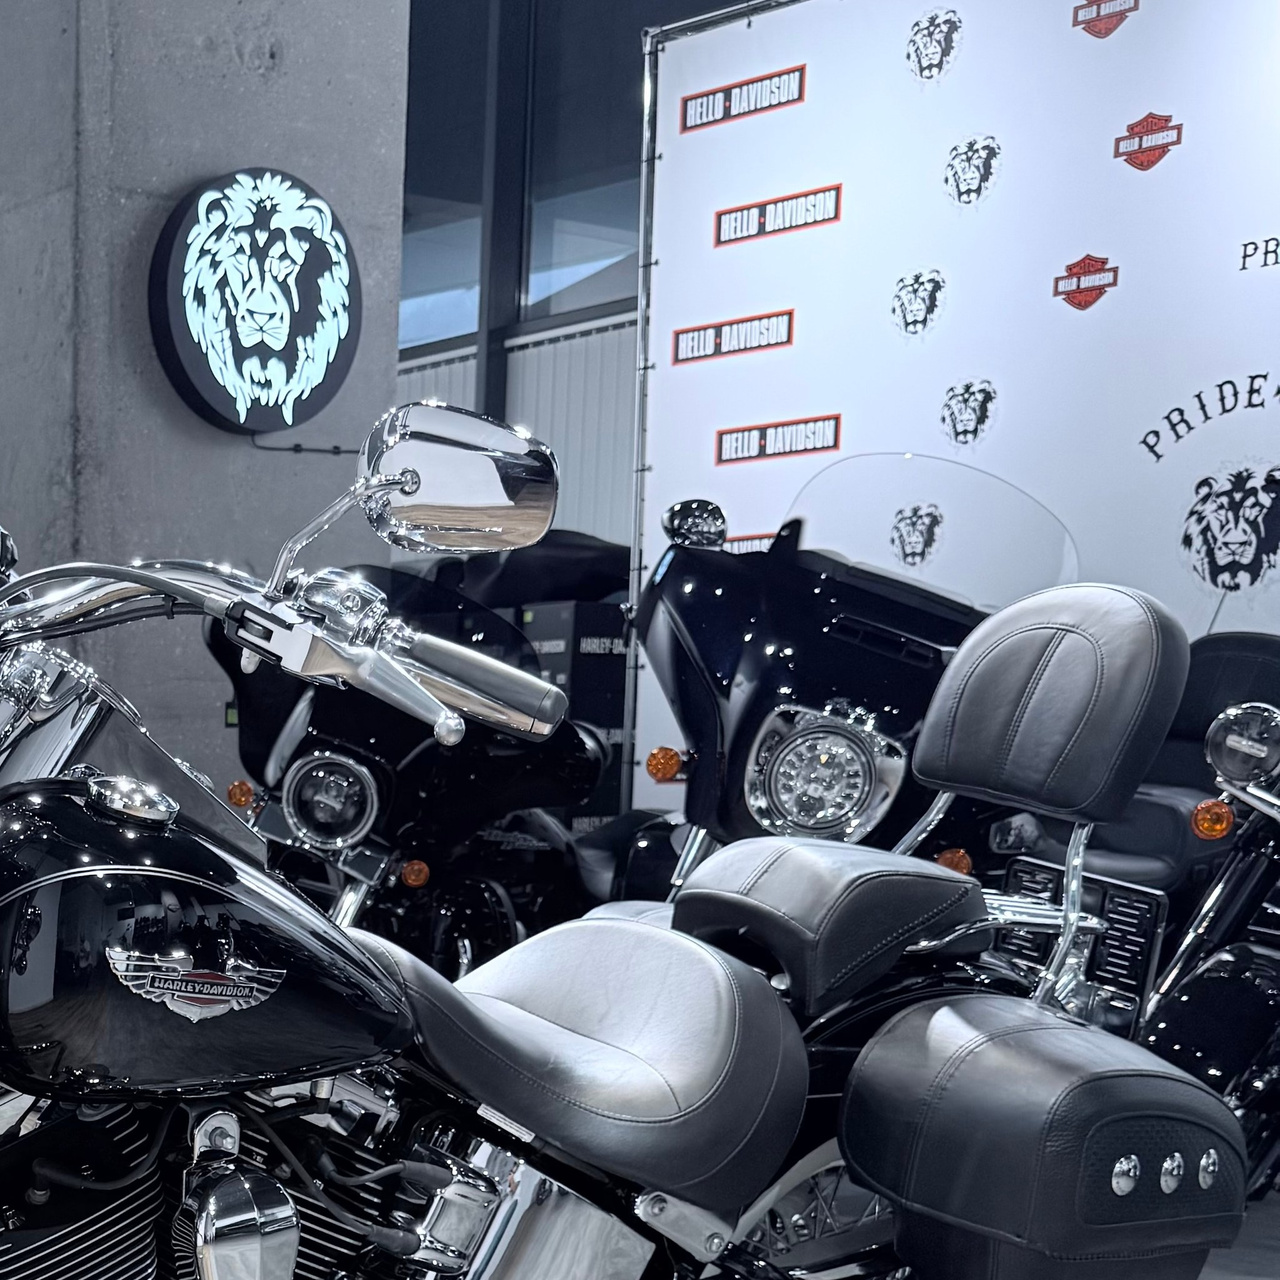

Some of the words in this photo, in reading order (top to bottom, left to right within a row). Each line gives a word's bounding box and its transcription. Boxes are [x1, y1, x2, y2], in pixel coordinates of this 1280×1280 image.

[686, 92, 725, 128] HELLO
[730, 71, 801, 116] DAVIDSON
[720, 208, 759, 242] HELLO
[765, 190, 837, 232] DAVIDSON
[677, 327, 715, 360] HELLO
[720, 314, 790, 353] DAVIDSON
[721, 429, 760, 461] HELLO
[765, 418, 836, 455] DAVIDSON
[1138, 371, 1269, 463] PRIDE
